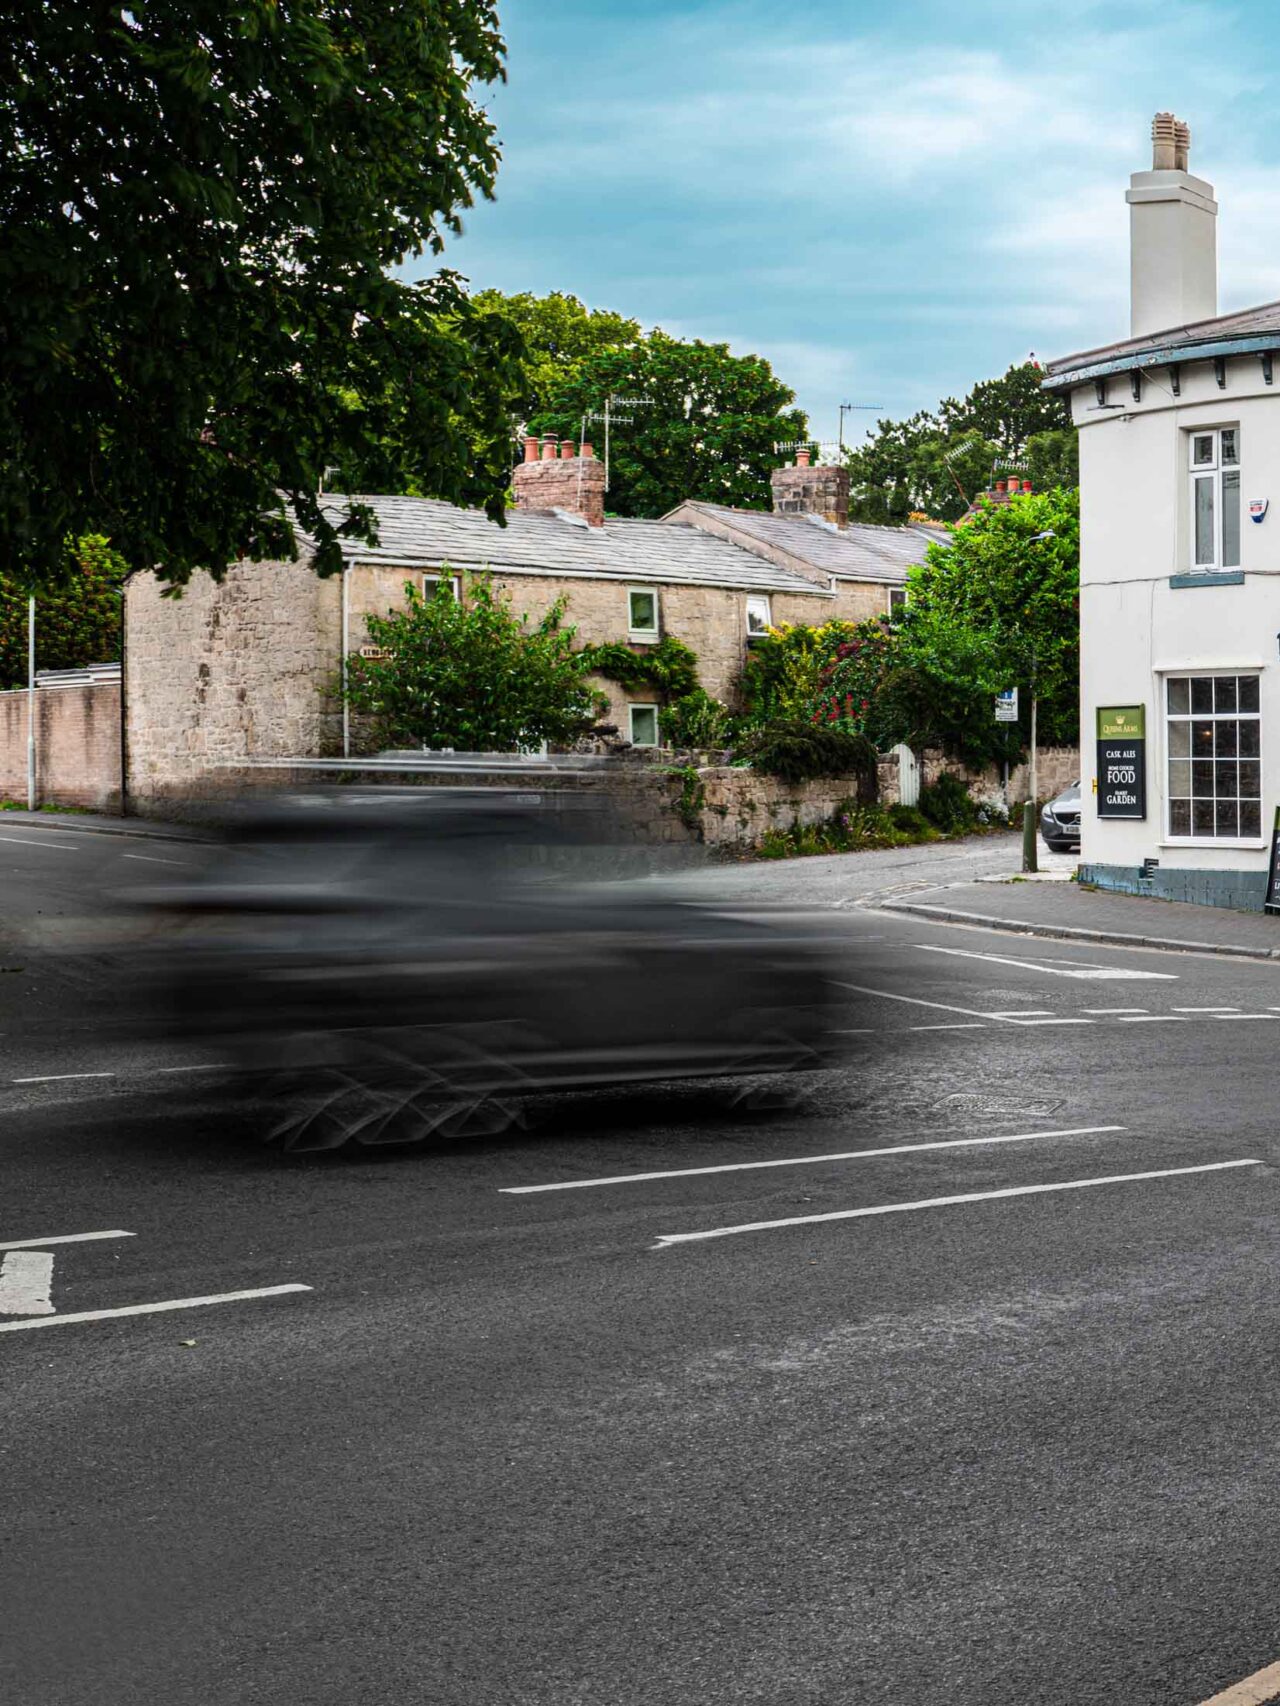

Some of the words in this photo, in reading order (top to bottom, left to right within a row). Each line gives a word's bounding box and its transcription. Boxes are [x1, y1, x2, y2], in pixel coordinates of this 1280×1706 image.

[1106, 750, 1121, 758] CASK
[1122, 750, 1136, 758] ALES
[1107, 771, 1136, 784] FOOD
[1106, 795, 1136, 804] GARDEN
